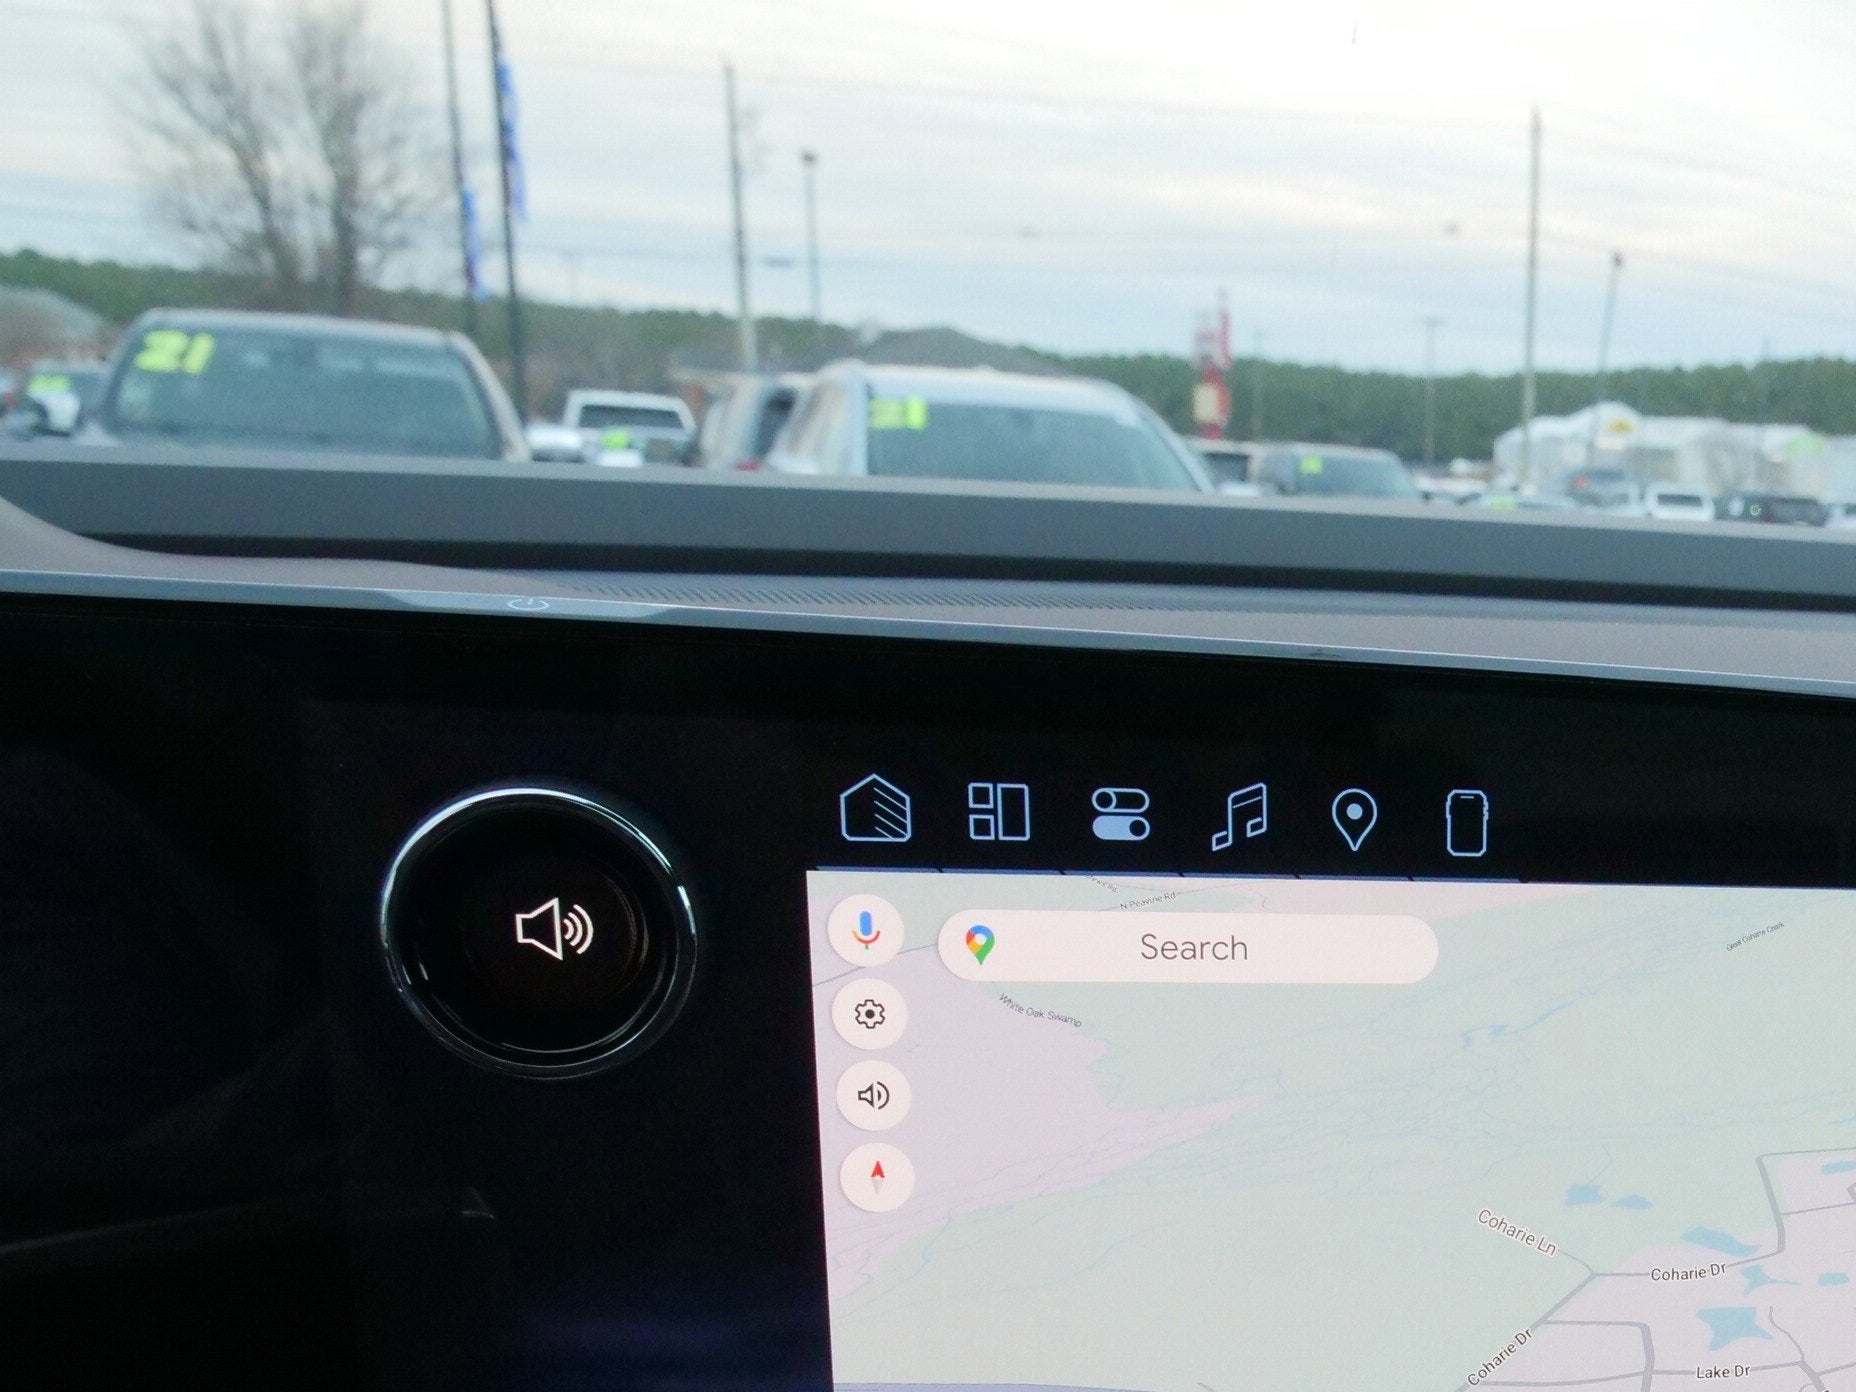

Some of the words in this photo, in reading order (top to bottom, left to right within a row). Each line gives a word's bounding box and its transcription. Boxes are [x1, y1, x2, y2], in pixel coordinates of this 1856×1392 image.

[1163, 891, 1177, 902] Rd
[1140, 933, 1249, 961] Search
[999, 993, 1024, 1014] White
[1025, 1006, 1046, 1019] Oak
[1047, 1010, 1083, 1029] Swamp
[1477, 1208, 1536, 1247] Coharie
[1537, 1236, 1558, 1257] Ln
[1650, 1267, 1707, 1282] Coharie
[1710, 1262, 1726, 1276] Dr
[1467, 1342, 1517, 1386] Coharie
[1514, 1328, 1533, 1346] Dr
[1696, 1365, 1730, 1379] Lake
[1734, 1364, 1751, 1377] Dr
